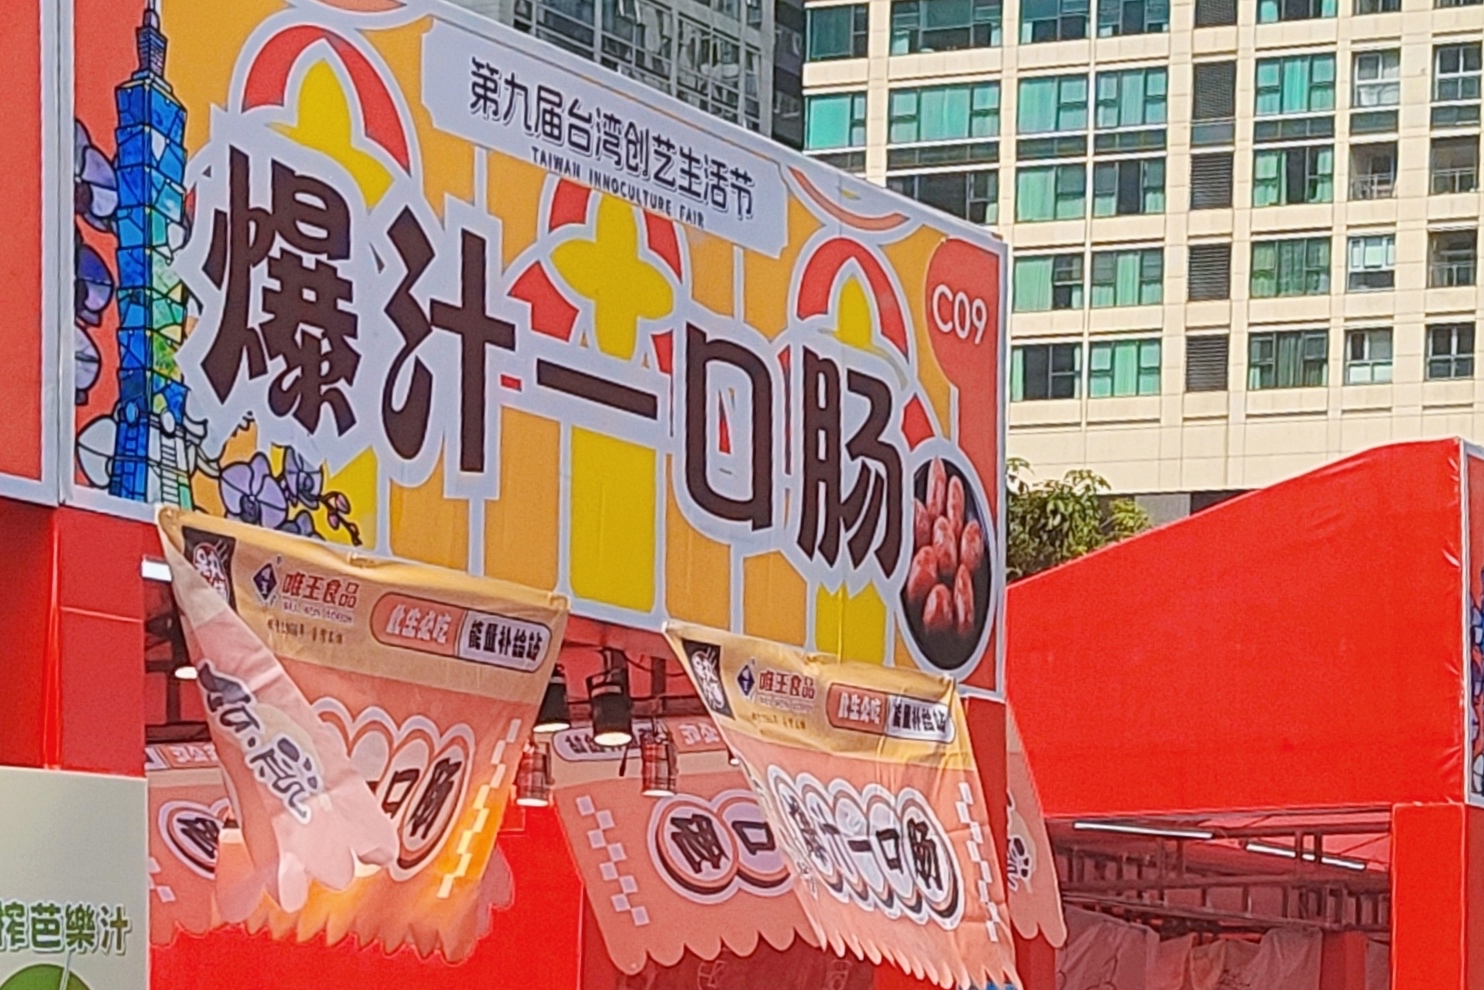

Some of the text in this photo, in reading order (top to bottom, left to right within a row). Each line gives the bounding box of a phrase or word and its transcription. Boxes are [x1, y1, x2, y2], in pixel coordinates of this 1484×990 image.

[470, 56, 756, 221] 第九届台湾创艺生活节
[531, 146, 706, 229] TAIWAN INNOCULTURE FAIR
[932, 275, 989, 346] C09
[202, 146, 905, 577] 爆汁一口肠
[282, 571, 360, 610] 唯王食品
[467, 613, 541, 662] 能量补给站
[758, 669, 816, 700] 唯王食品
